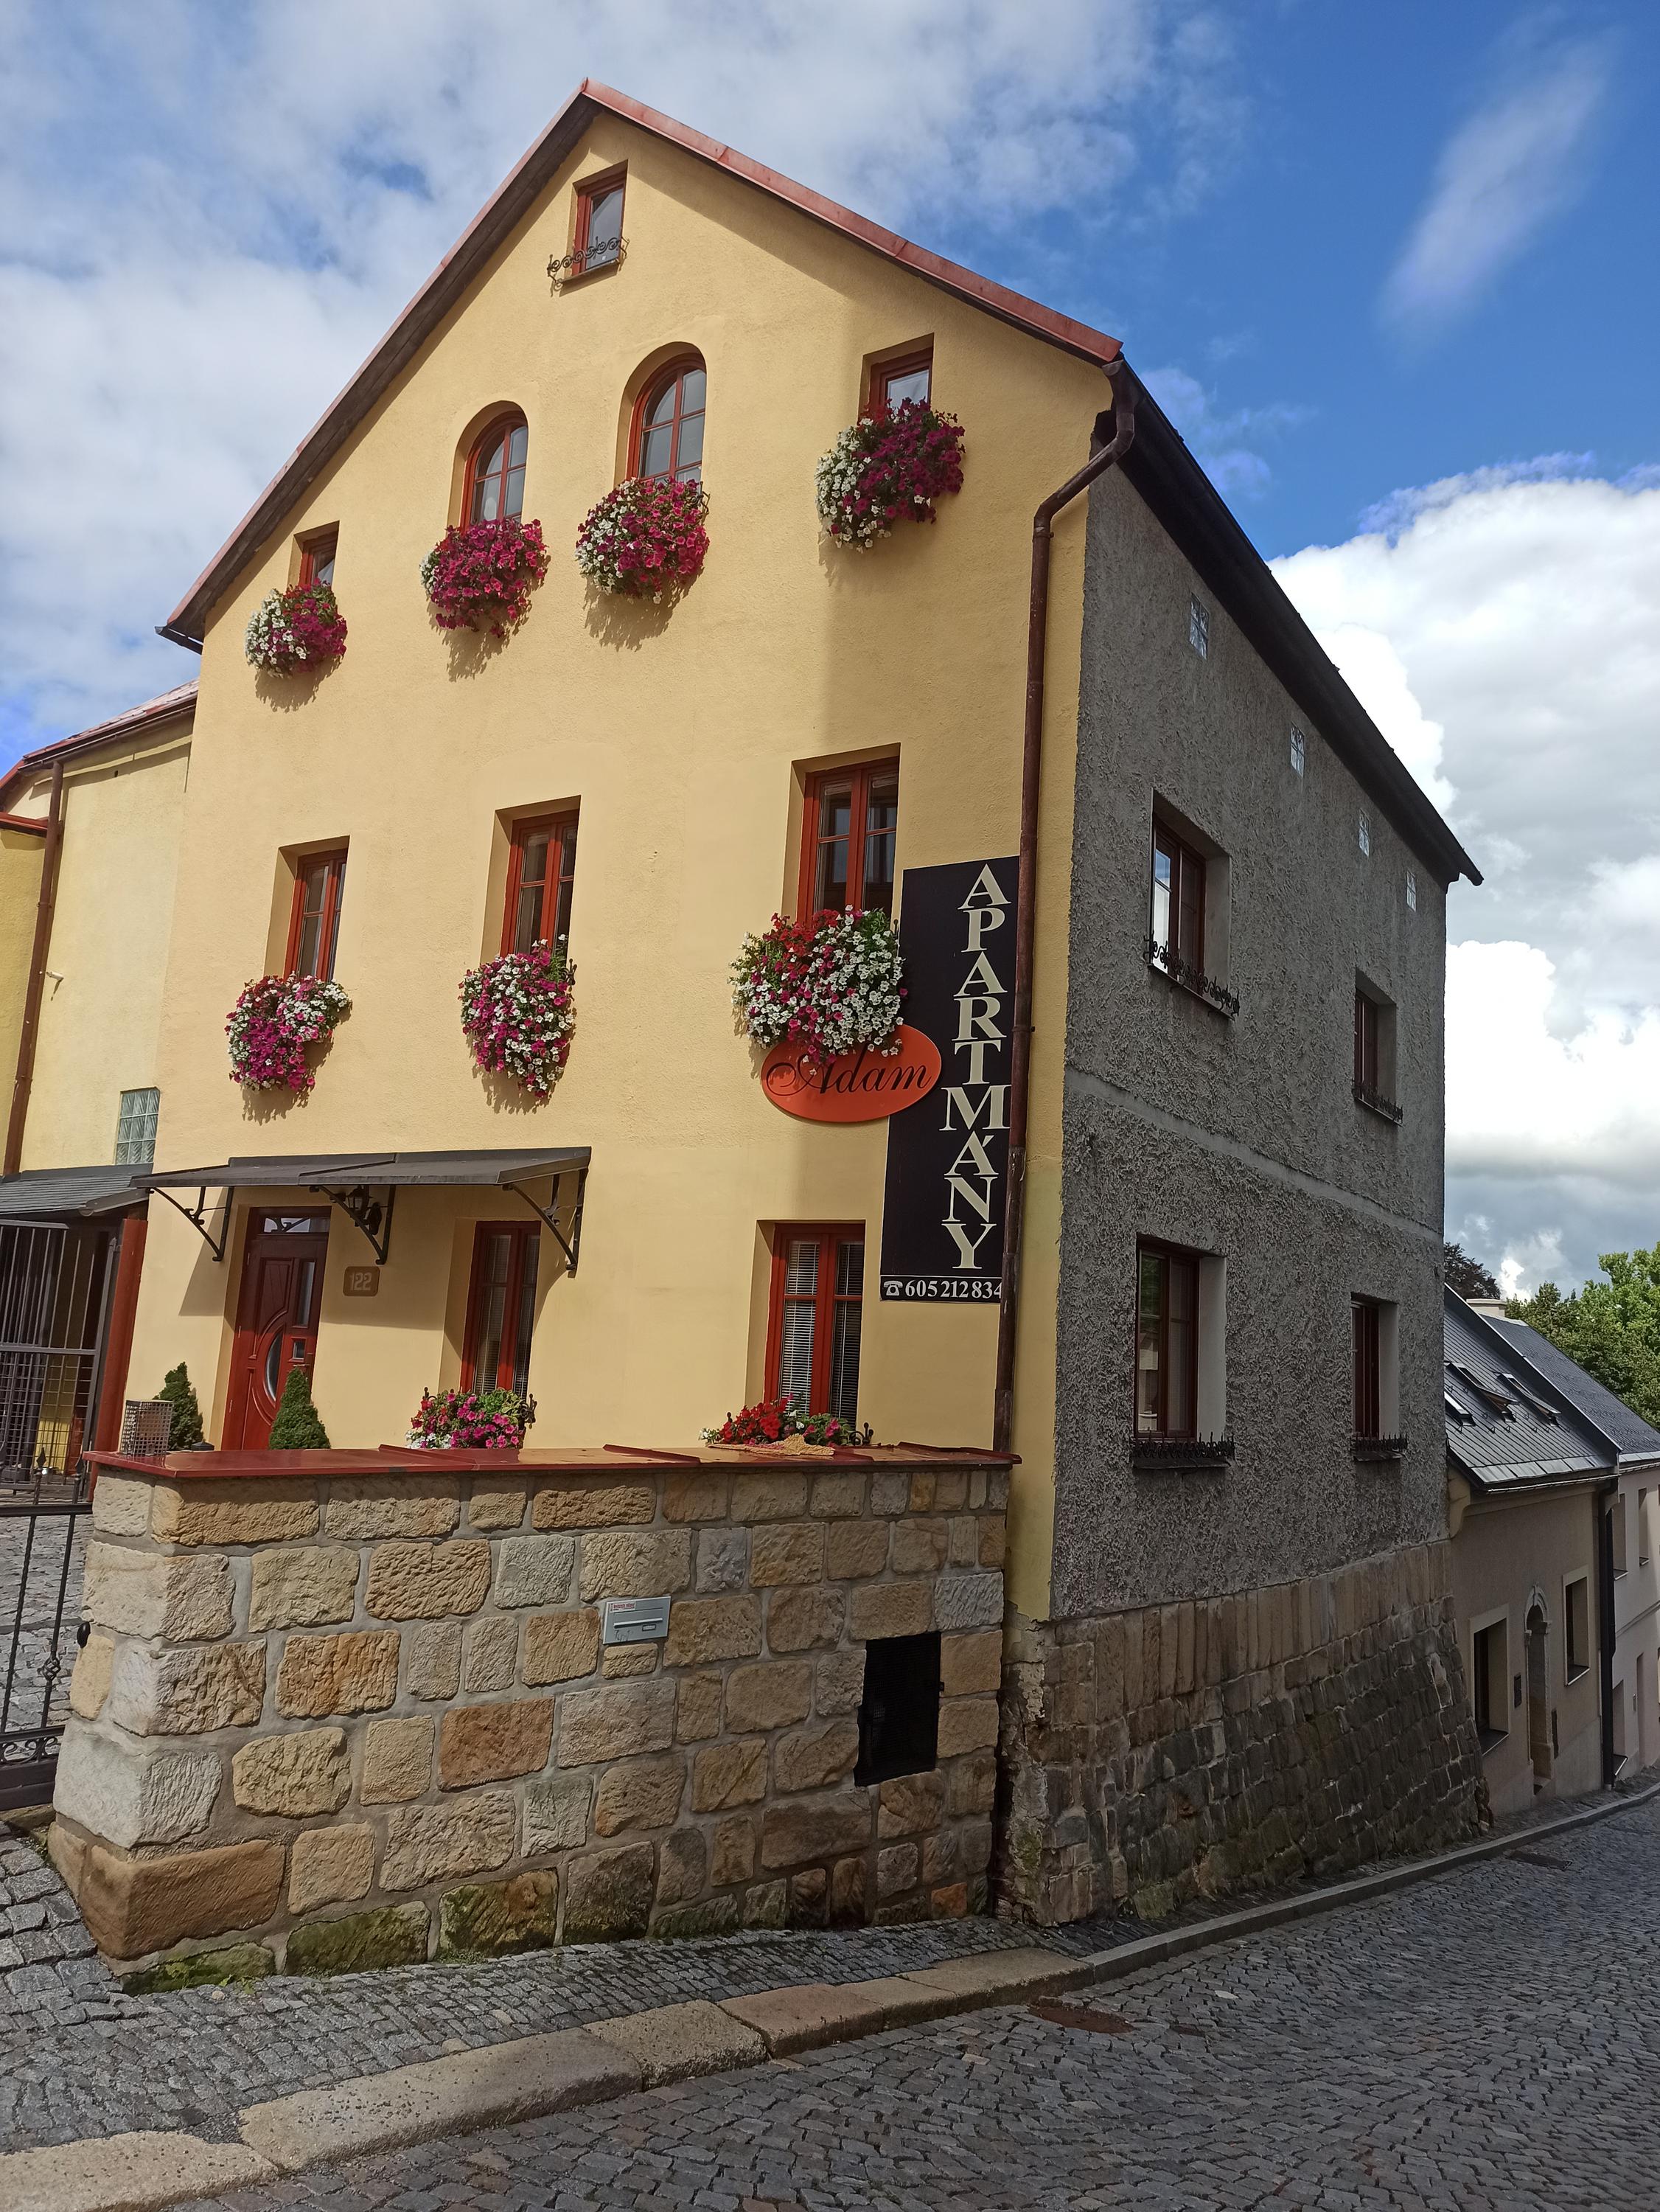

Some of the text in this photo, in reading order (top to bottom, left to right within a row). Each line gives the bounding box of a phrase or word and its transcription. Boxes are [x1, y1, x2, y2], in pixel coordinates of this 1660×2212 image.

[766, 1038, 932, 1096] Adam
[938, 863, 1012, 1270] APARTMÁNY
[349, 1272, 372, 1291] 122
